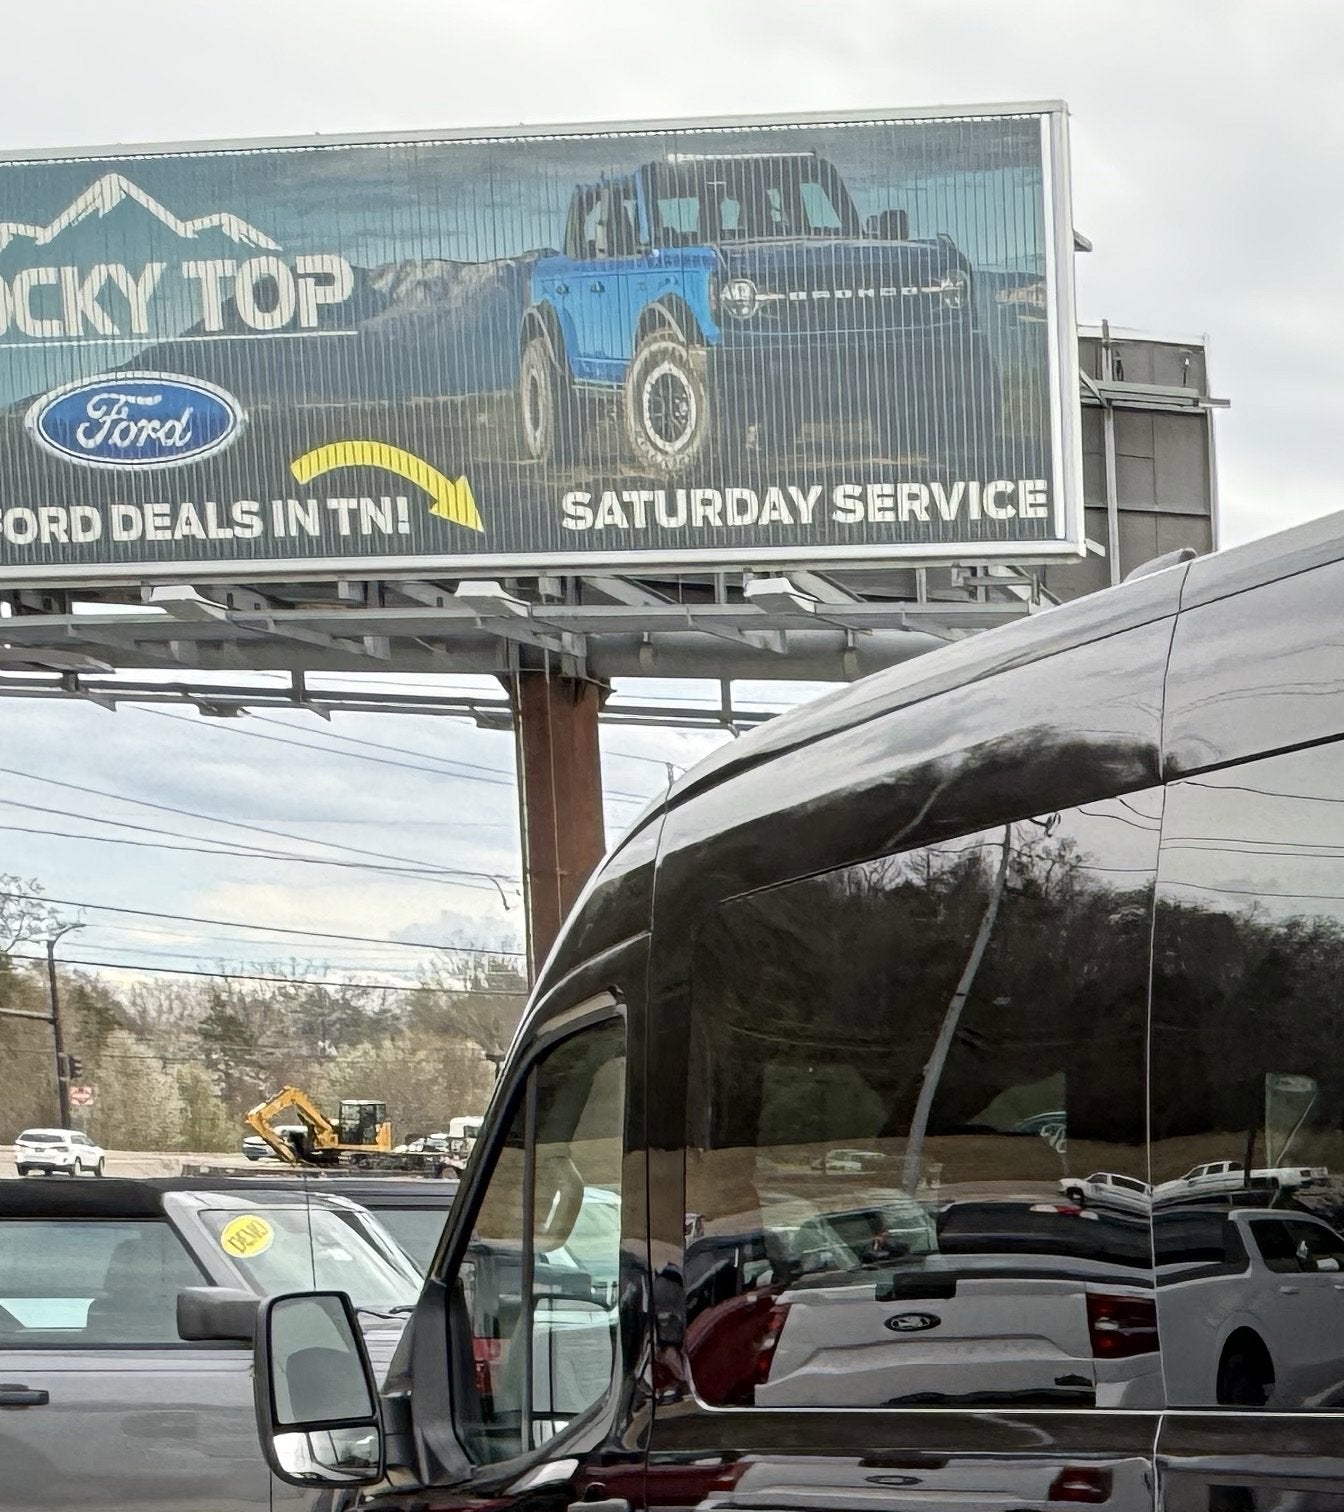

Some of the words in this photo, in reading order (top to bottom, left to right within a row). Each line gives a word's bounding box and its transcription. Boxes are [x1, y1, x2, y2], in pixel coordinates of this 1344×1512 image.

[0, 262, 167, 337] CKY
[182, 254, 355, 333] TOP
[75, 392, 193, 449] Ford
[0, 505, 101, 545] ORD
[110, 499, 264, 542] DEALS
[271, 499, 319, 538] IN
[327, 496, 411, 537] TN!
[561, 485, 823, 531] SATURDAY
[831, 479, 1049, 525] SERVICE
